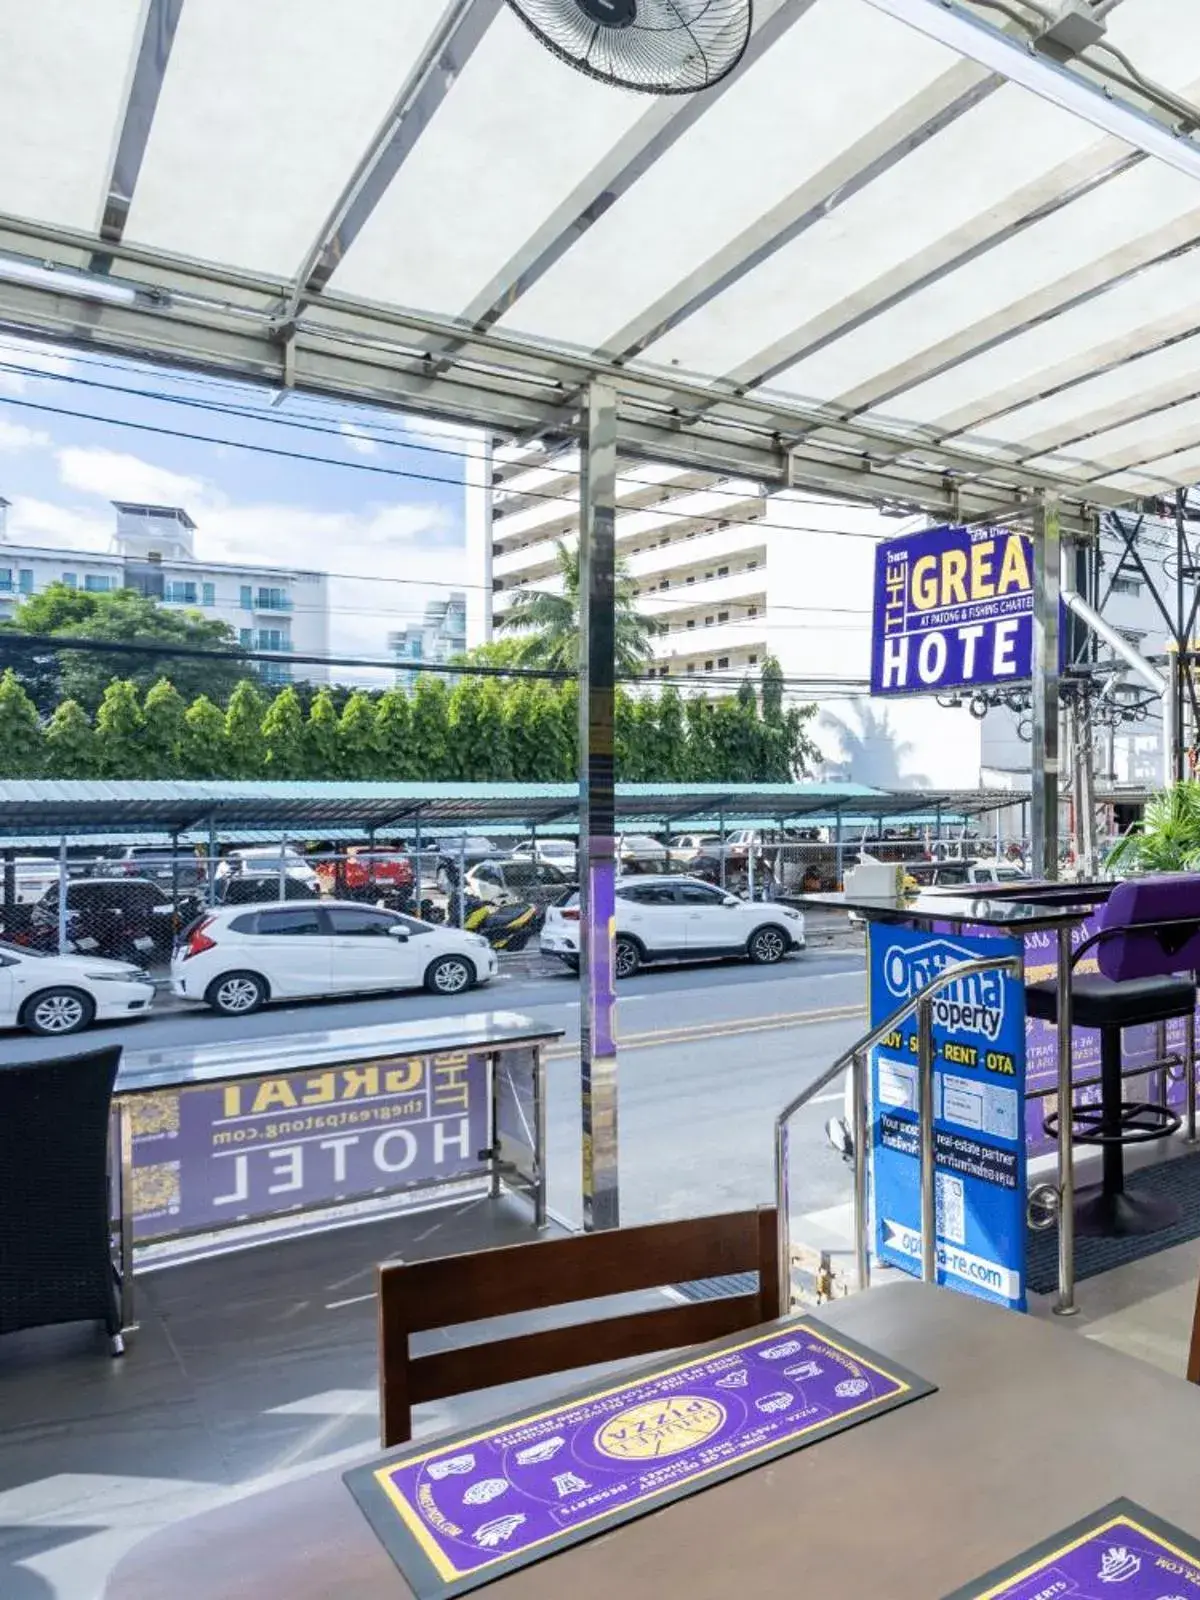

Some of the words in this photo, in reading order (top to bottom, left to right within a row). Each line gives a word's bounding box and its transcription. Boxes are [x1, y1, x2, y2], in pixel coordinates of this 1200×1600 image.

[885, 562, 905, 633] THE
[911, 535, 1031, 611] GREA
[1000, 597, 1033, 613] CHARTE
[882, 619, 1020, 688] HOTE
[884, 946, 1003, 1010] Opma
[932, 1001, 1000, 1036] operty
[944, 1044, 977, 1065] RENT
[987, 1053, 1014, 1075] OTA
[882, 1114, 898, 1130] Your
[937, 1133, 980, 1156] real-estate
[982, 1147, 1015, 1166] partner
[902, 1232, 1001, 1288] opa-re.com
[604, 1400, 708, 1444] PIZZA
